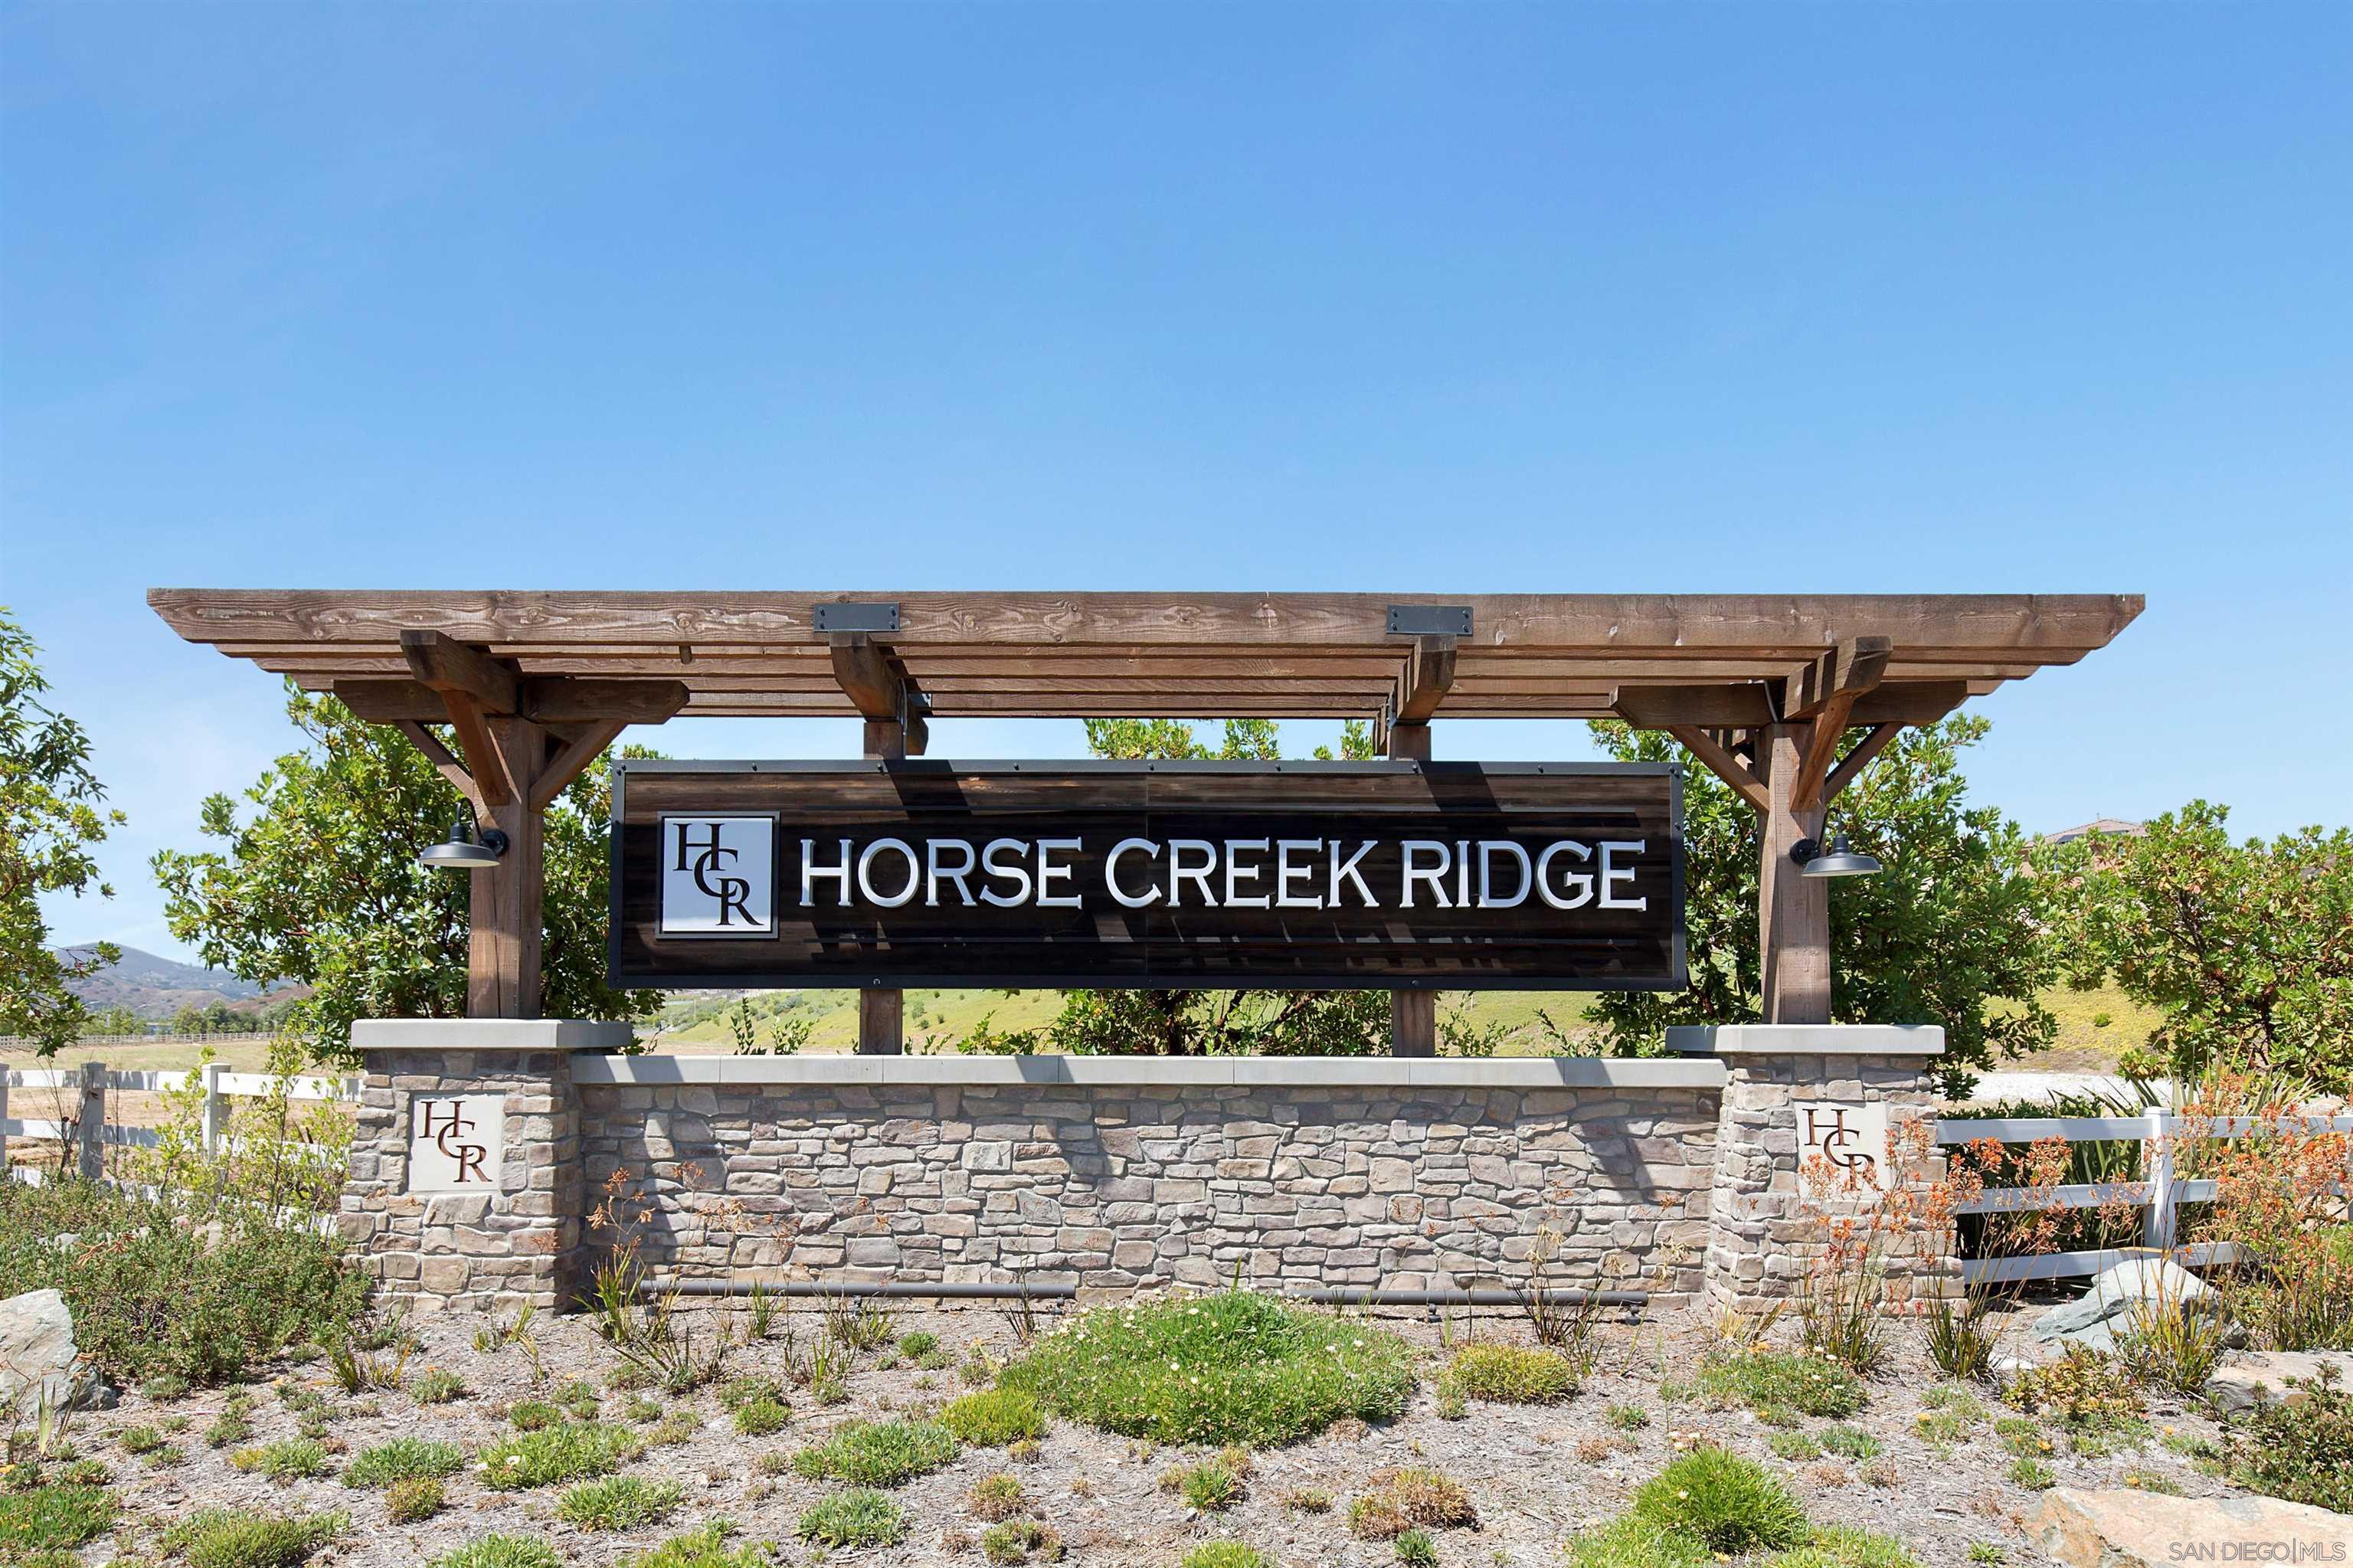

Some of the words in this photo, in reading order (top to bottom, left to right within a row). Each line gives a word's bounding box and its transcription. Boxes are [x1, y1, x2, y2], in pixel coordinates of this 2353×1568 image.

[799, 836, 1082, 909] HORSE
[1105, 837, 1379, 909] CREEK
[1399, 840, 1647, 911] RIDGE
